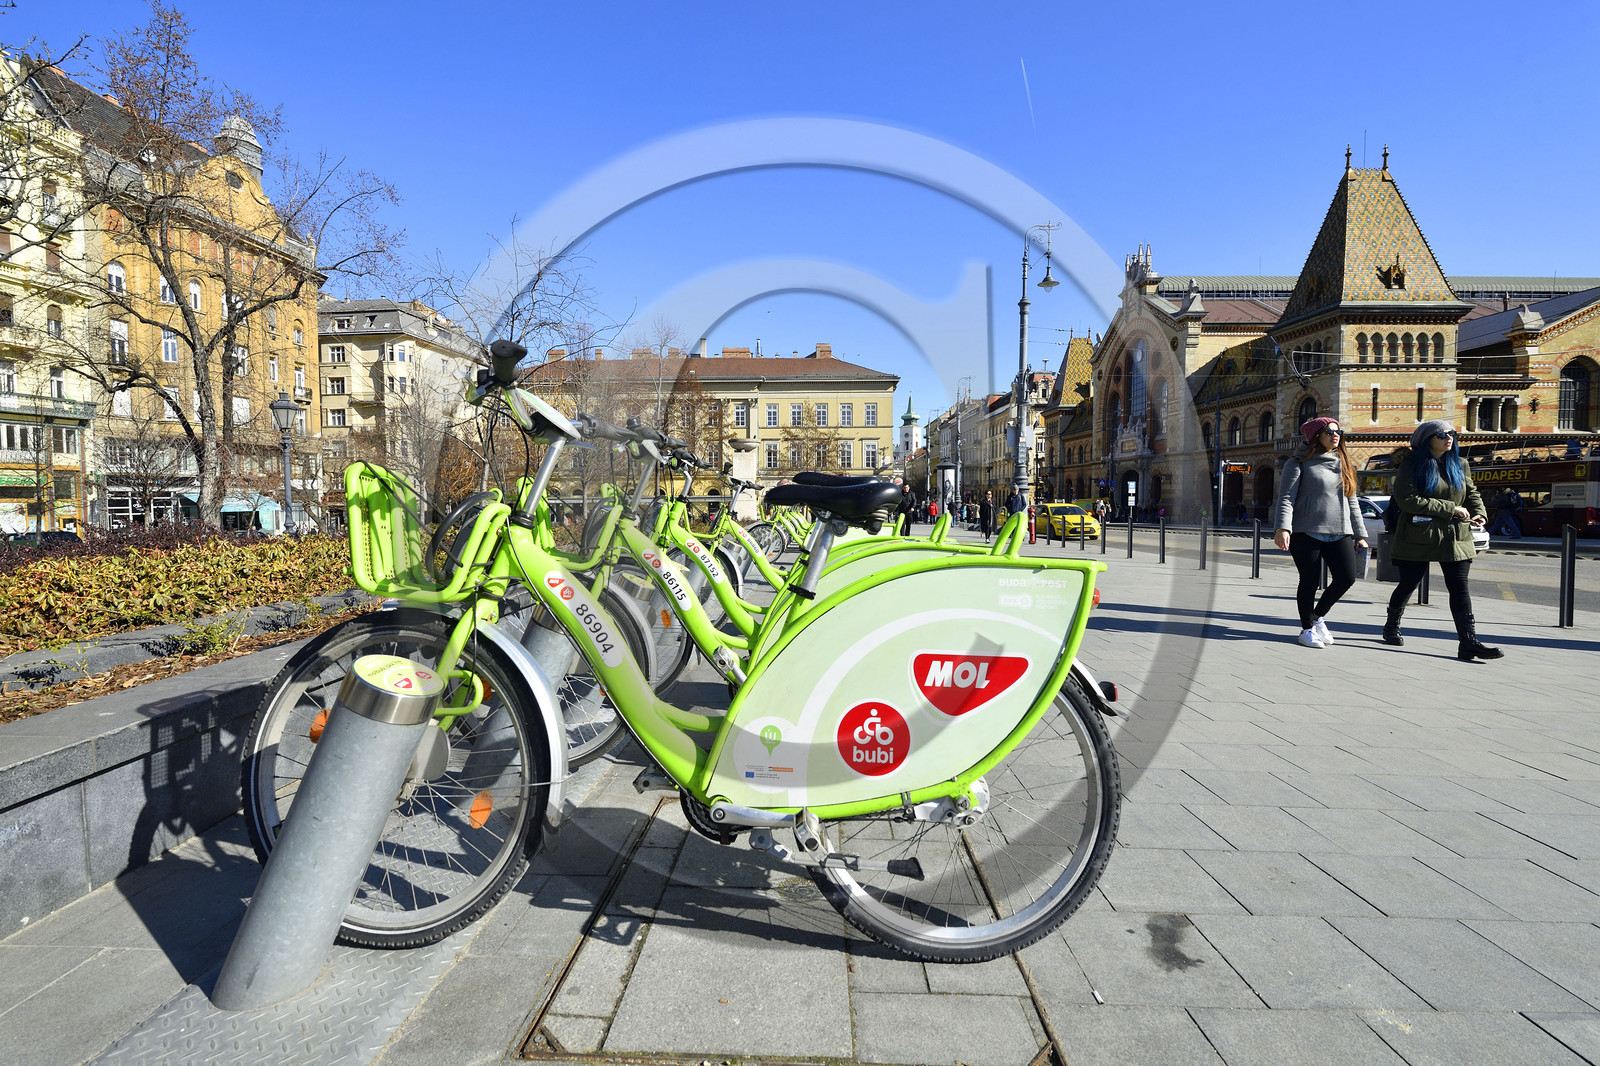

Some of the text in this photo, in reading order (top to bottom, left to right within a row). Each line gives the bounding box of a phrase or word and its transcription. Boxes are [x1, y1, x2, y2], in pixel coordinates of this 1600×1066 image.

[1471, 469, 1530, 481] BUDAPEST
[700, 554, 719, 578] 87152
[663, 571, 687, 601] 86115
[575, 603, 615, 654] 86904
[924, 660, 991, 689] MOL
[852, 745, 894, 764] bubi
